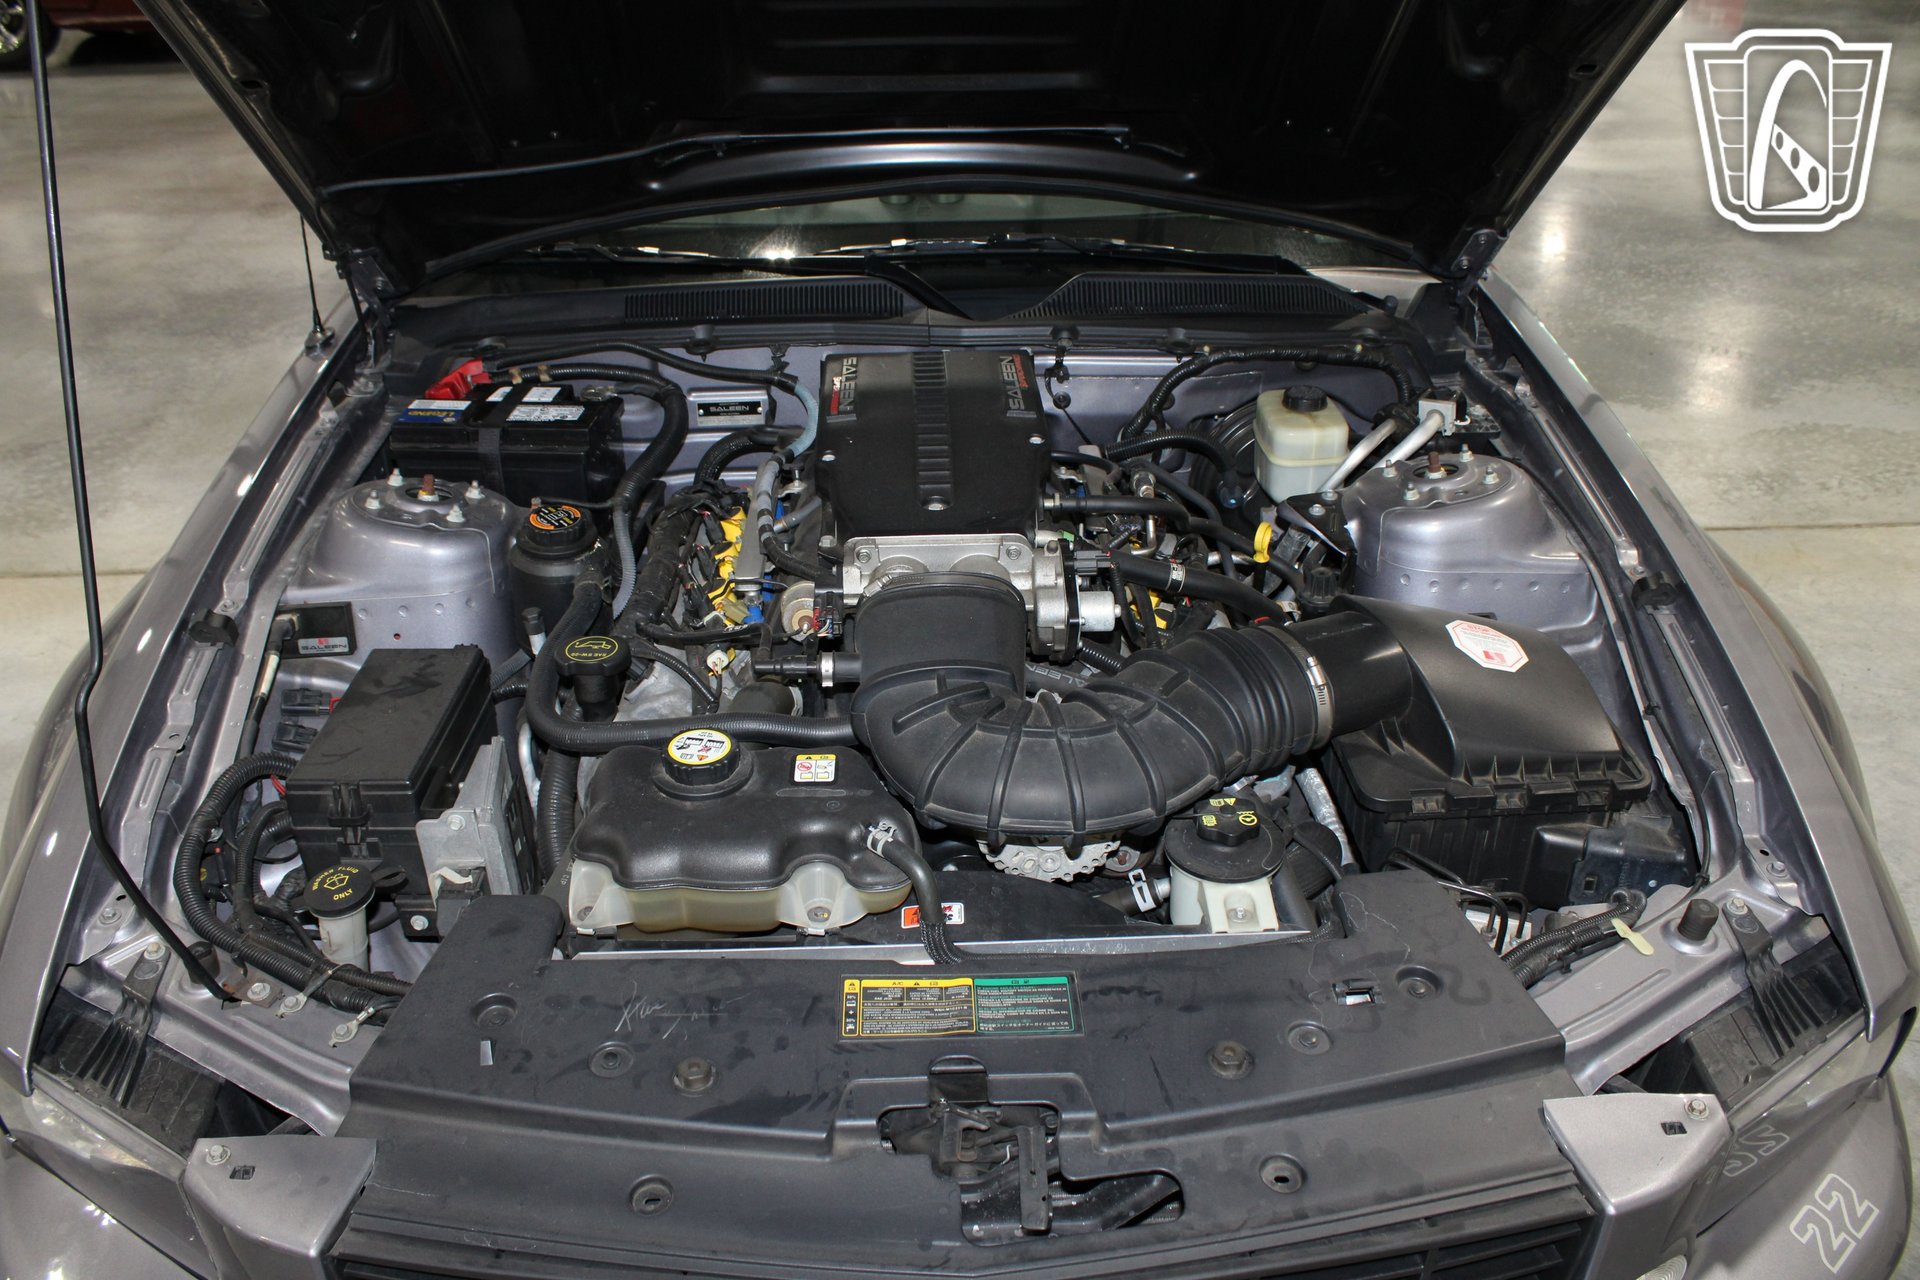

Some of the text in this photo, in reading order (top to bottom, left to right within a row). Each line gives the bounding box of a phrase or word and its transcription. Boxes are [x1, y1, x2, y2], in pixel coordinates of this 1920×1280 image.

[841, 357, 858, 411] SALEEN
[1001, 356, 1025, 411] SALEEN
[709, 405, 749, 413] SALEEN
[1024, 663, 1089, 688] ALEEN
[338, 866, 359, 874] FLUID
[333, 888, 353, 901] ONLY
[1789, 1173, 1880, 1274] 22
